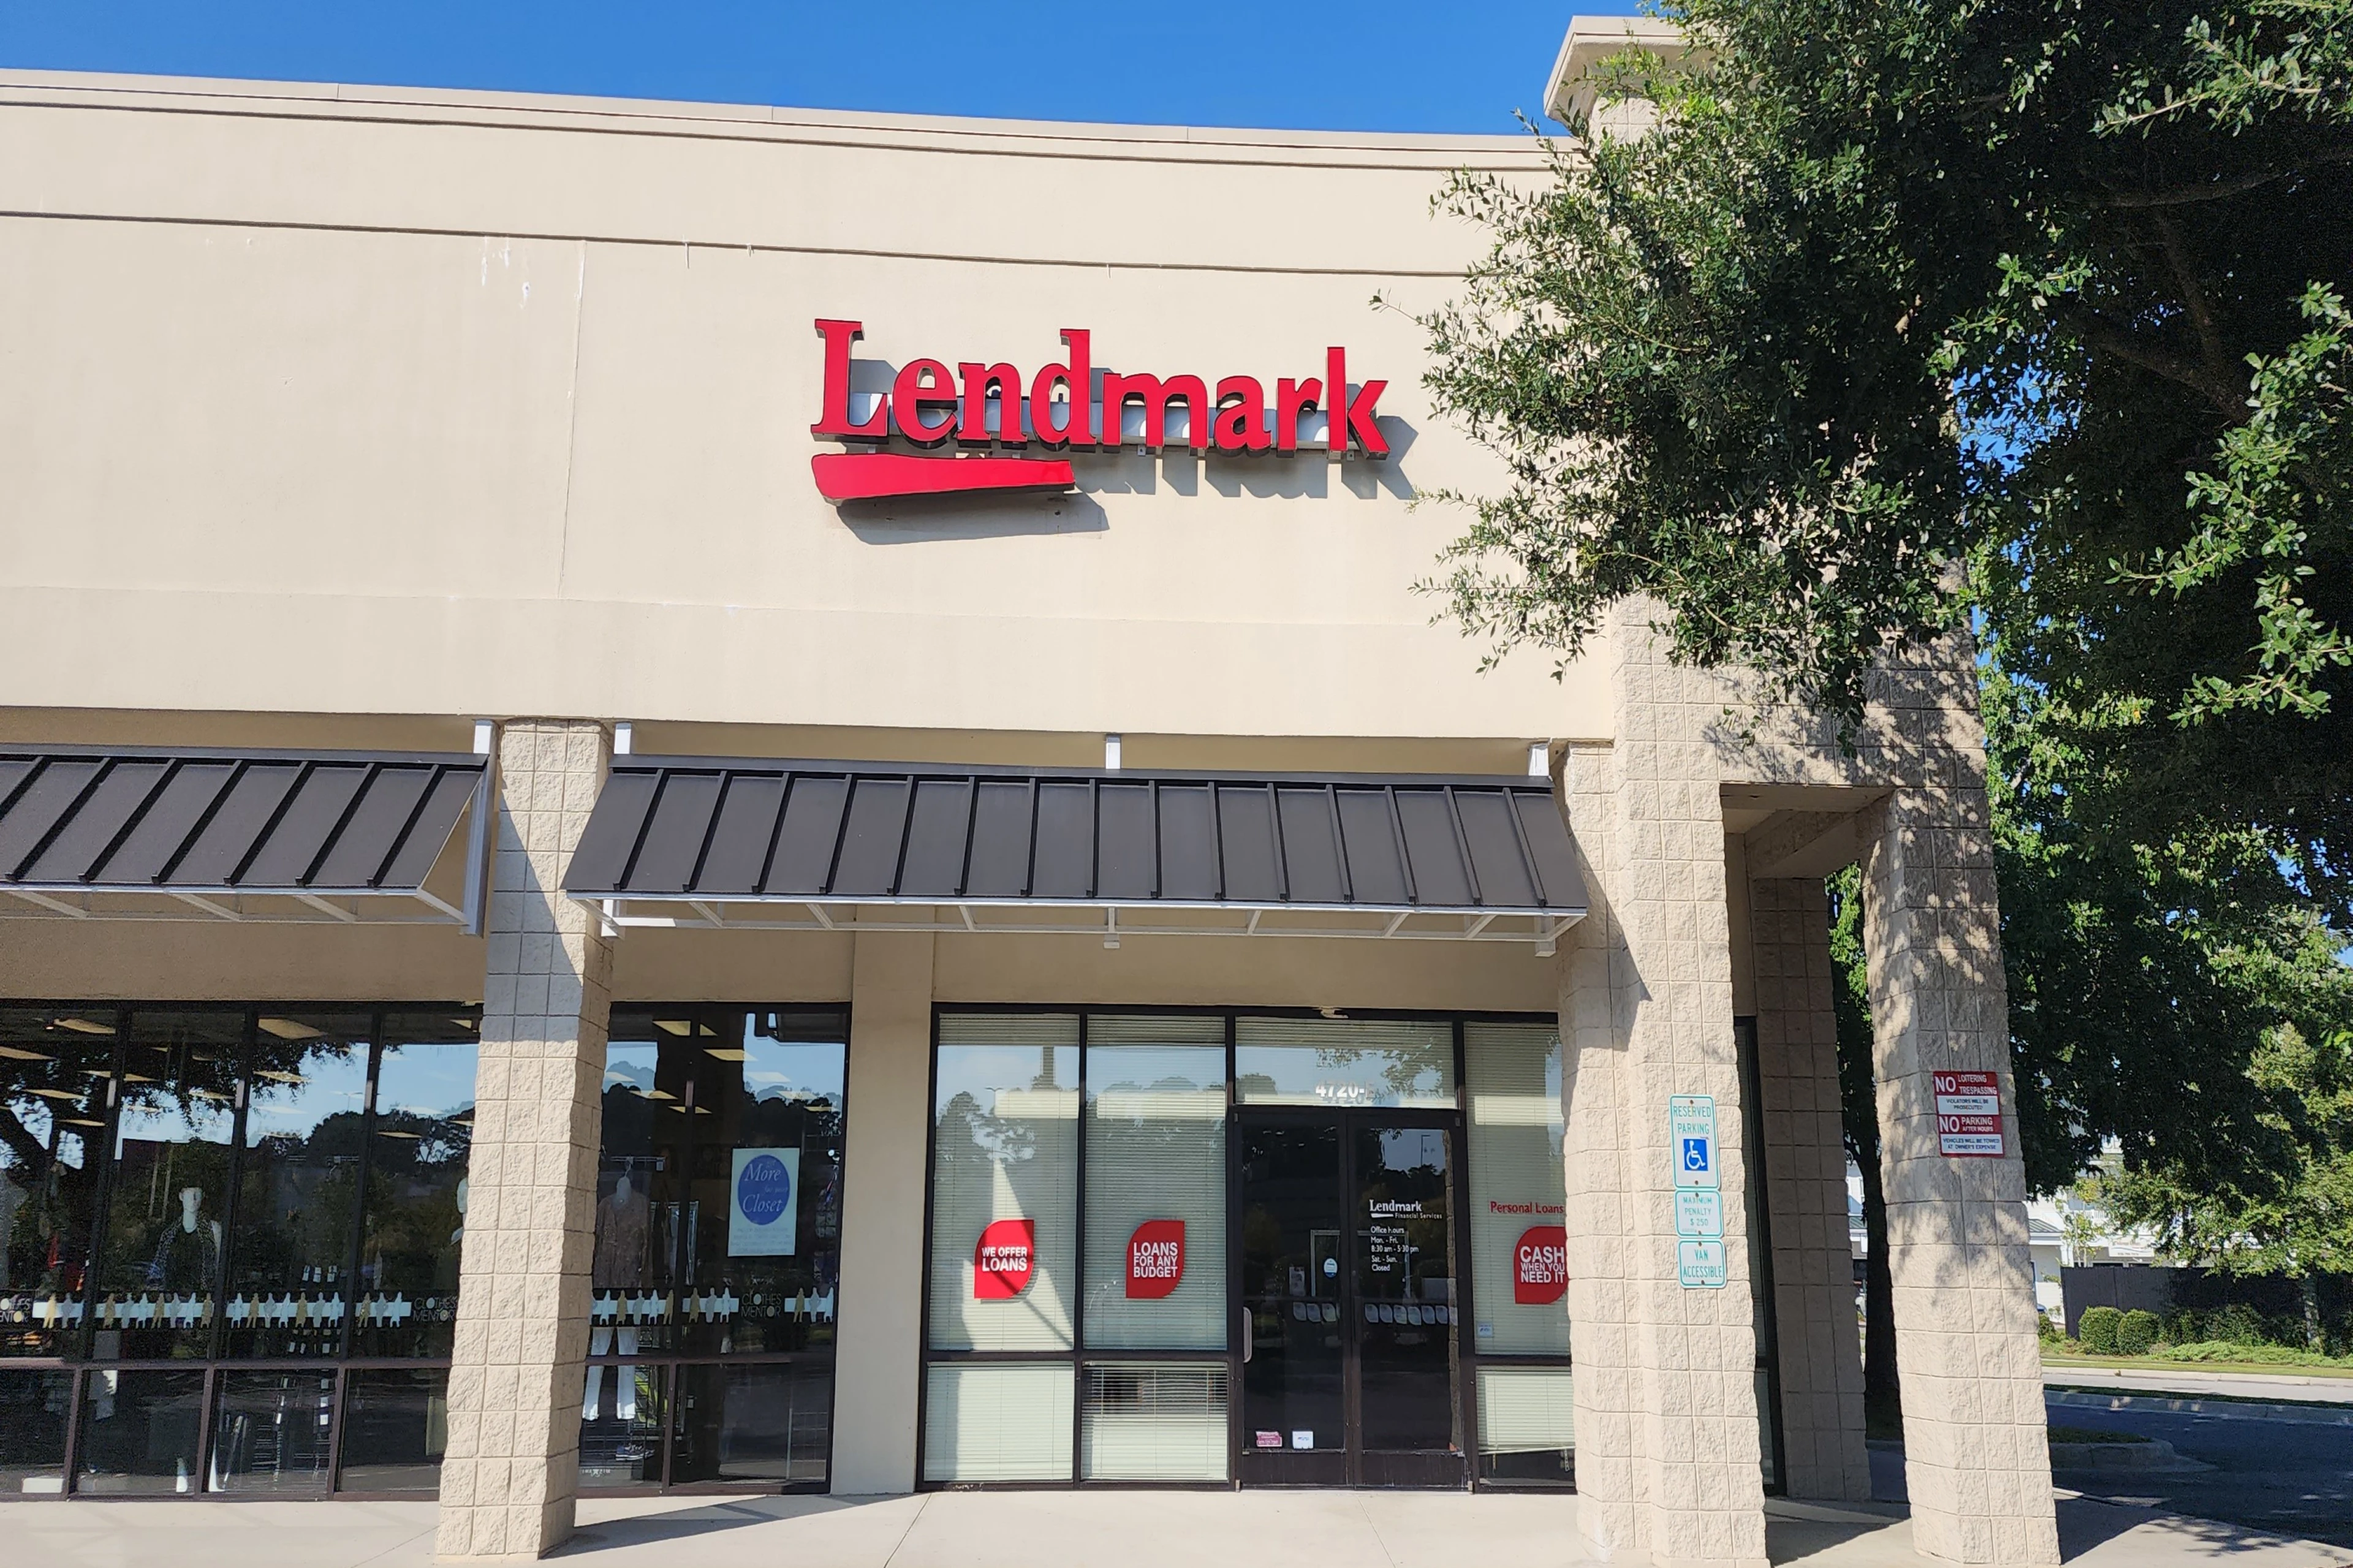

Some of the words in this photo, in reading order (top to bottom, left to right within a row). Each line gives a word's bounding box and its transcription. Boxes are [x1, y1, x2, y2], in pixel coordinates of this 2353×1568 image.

[810, 318, 1391, 458] Lendmark
[1934, 1076, 1957, 1093] NO
[1957, 1074, 1987, 1083] LOITERING
[1958, 1086, 1998, 1095] TRESPASSING
[1673, 1105, 1711, 1118] RESERVED
[1677, 1123, 1710, 1135] PARKING
[1938, 1116, 1960, 1132] NO
[1961, 1116, 1993, 1126] PARKING
[744, 1164, 782, 1181] More
[742, 1193, 782, 1213] Closet
[1369, 1199, 1422, 1212] Lendmark
[1683, 1196, 1713, 1205] MAXIMUM
[1490, 1201, 1533, 1213] Personal
[1536, 1202, 1564, 1213] Loans
[1689, 1218, 1694, 1226] $
[982, 1246, 996, 1257] WE
[998, 1246, 1028, 1257] OFFER
[1134, 1242, 1178, 1256] LOANS
[1520, 1246, 1565, 1264] CASH
[1694, 1249, 1709, 1261] VAN
[982, 1257, 1028, 1272] LOANS
[1134, 1256, 1154, 1267] FOR
[1156, 1256, 1178, 1267] ANY
[1520, 1262, 1545, 1271] WHEN
[1547, 1263, 1565, 1271] YOU
[1134, 1266, 1178, 1278] BUDGET
[1520, 1271, 1552, 1283] NEED
[1555, 1271, 1565, 1284] IT
[1683, 1265, 1723, 1278] ACCESSIBLE
[0, 1298, 31, 1310] OTHES
[414, 1297, 457, 1309] CLOTHES
[741, 1293, 782, 1305] CLOTHES
[412, 1309, 455, 1322] MENTOR
[741, 1305, 781, 1317] MENTOR
